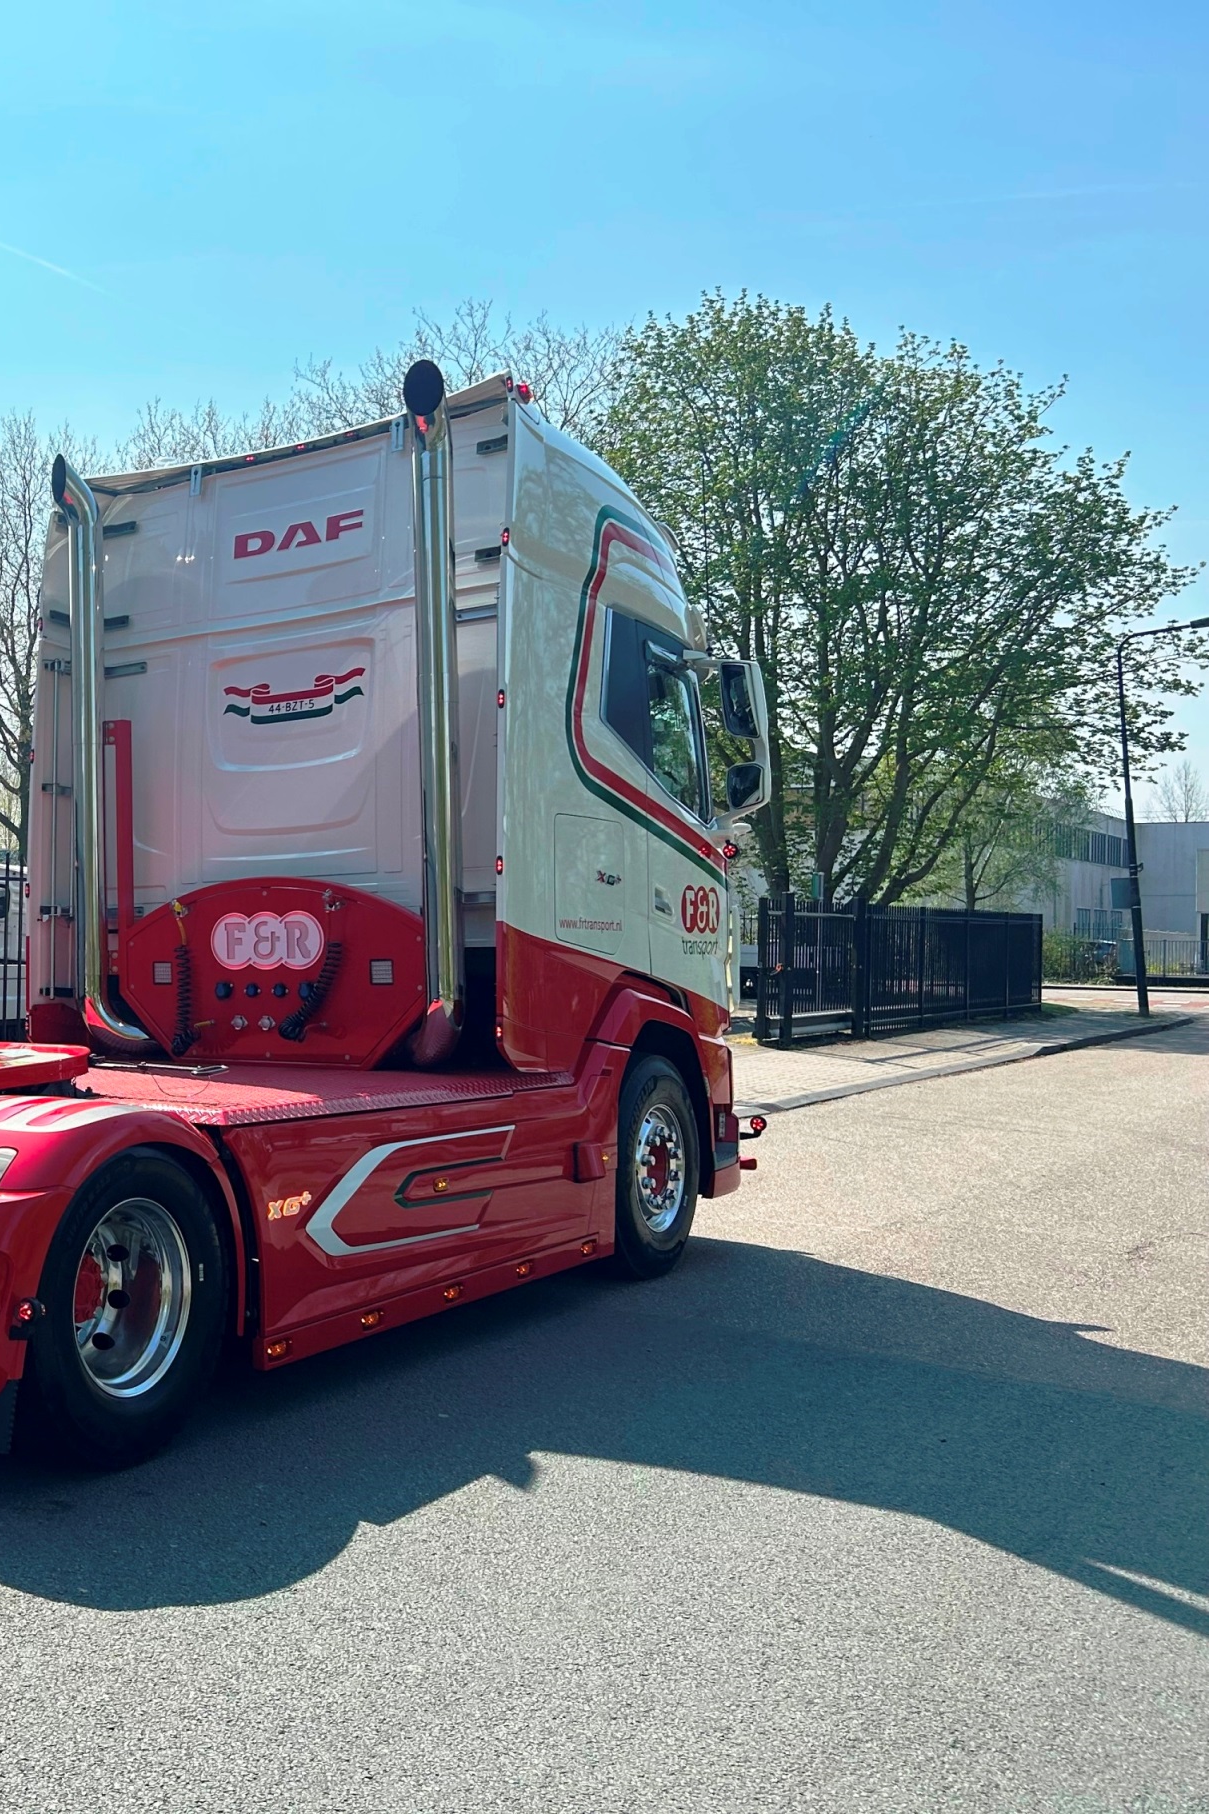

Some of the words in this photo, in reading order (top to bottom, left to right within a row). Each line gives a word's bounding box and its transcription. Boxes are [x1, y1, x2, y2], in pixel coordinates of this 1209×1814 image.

[234, 509, 364, 560] DAF
[268, 699, 315, 714] 44-BZT-5
[684, 889, 718, 929] F&R
[224, 920, 312, 960] F&R
[559, 917, 623, 934] www.frtransport.nl
[681, 936, 719, 960] transport
[268, 1191, 312, 1221] XG+
